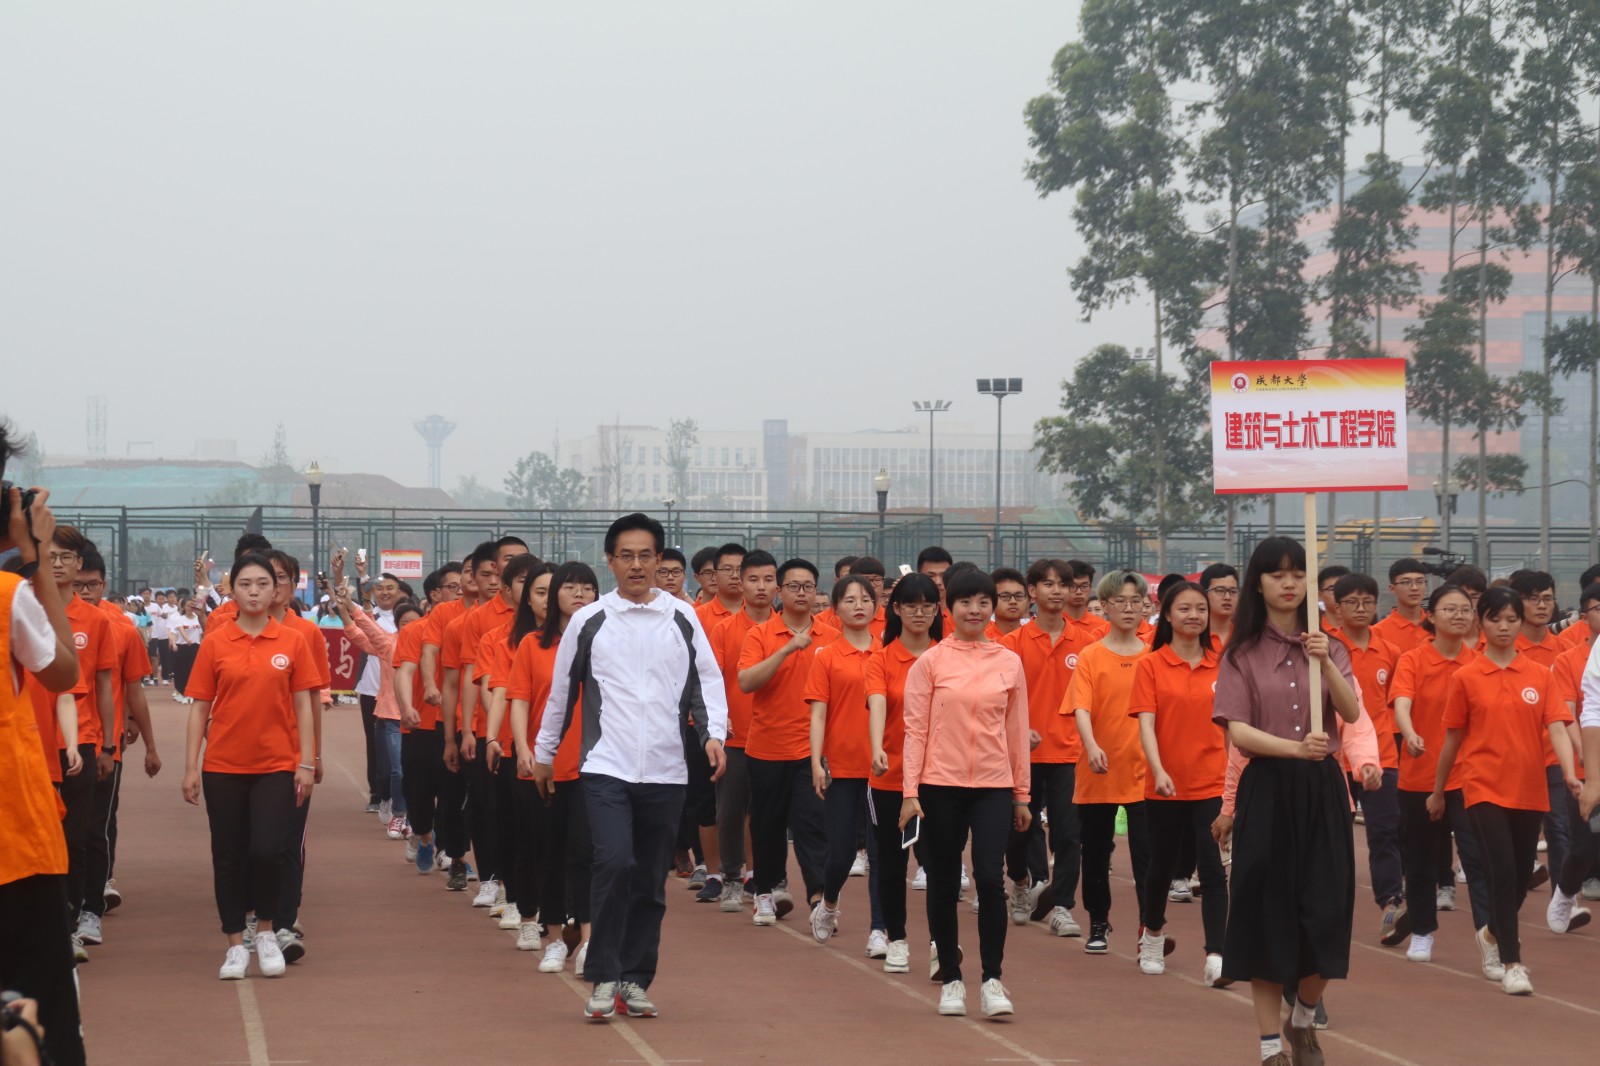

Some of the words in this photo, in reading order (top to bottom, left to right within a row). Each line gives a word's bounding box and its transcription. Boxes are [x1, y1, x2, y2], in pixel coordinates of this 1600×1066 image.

[1225, 409, 1397, 450] 建筑与土木工程学院
[326, 636, 354, 679] 与
